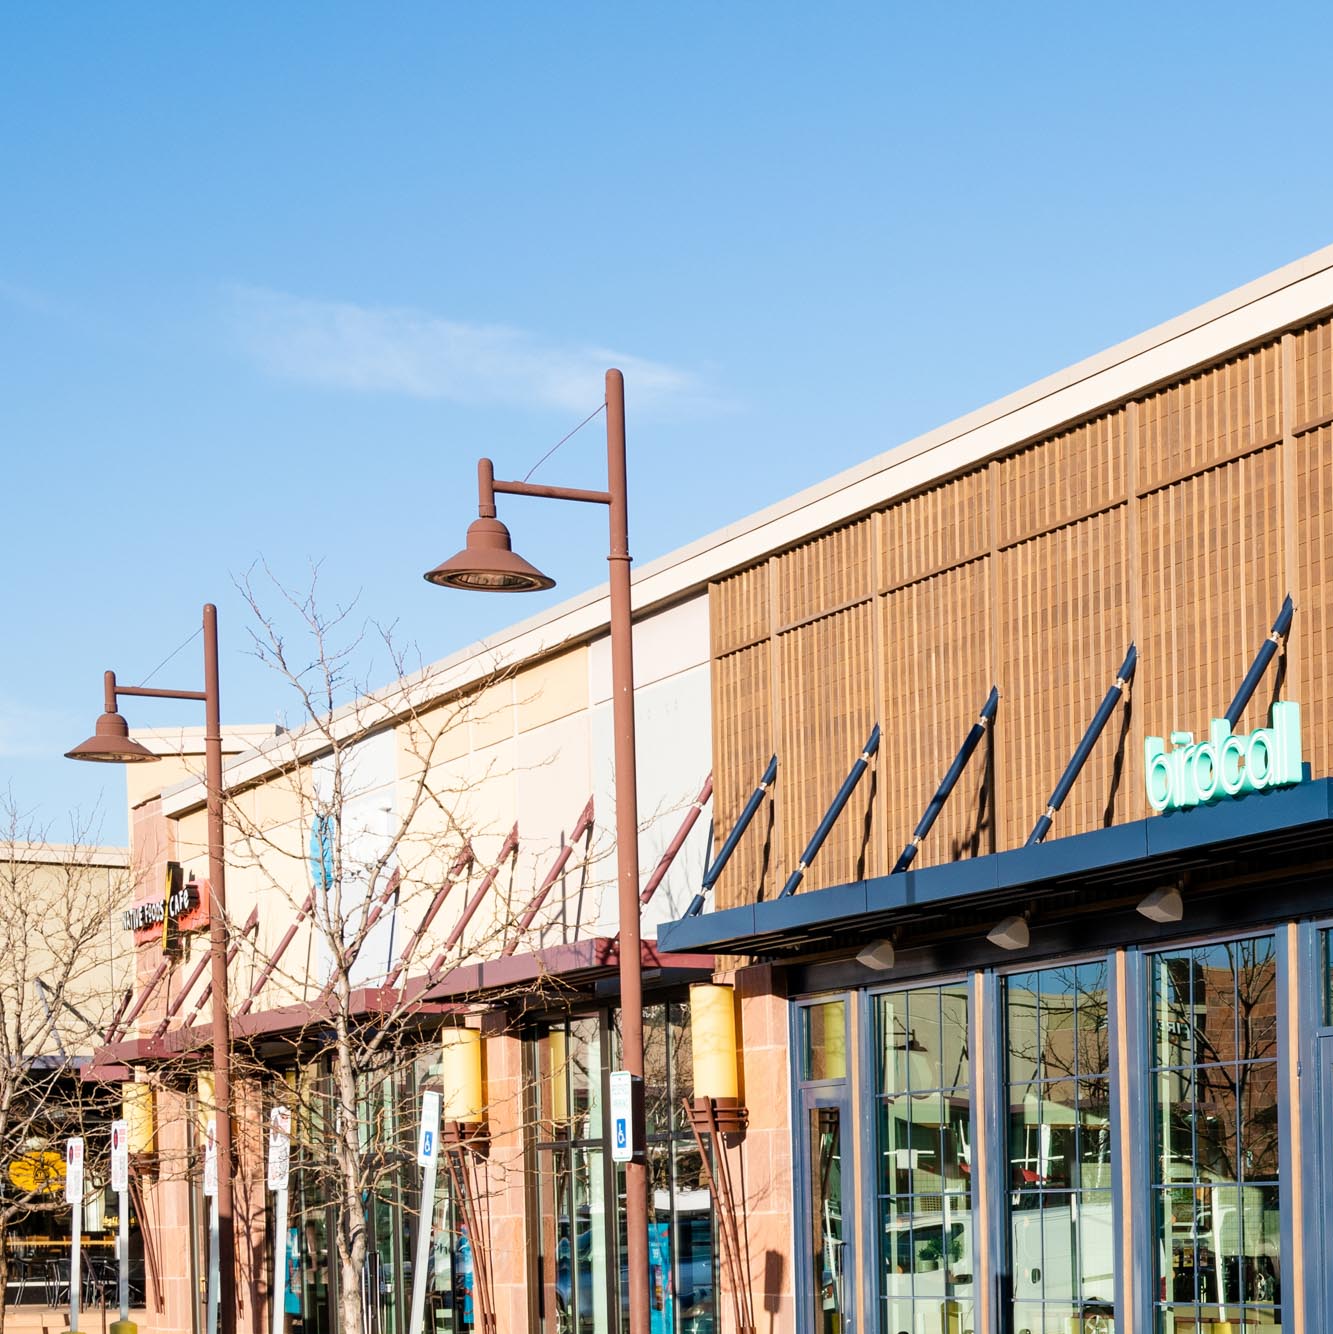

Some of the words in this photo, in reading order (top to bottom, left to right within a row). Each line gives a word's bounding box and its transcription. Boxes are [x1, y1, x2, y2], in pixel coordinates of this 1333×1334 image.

[1144, 701, 1302, 812] birdcall
[123, 908, 143, 930] NATIVE
[145, 900, 164, 923] FOODS
